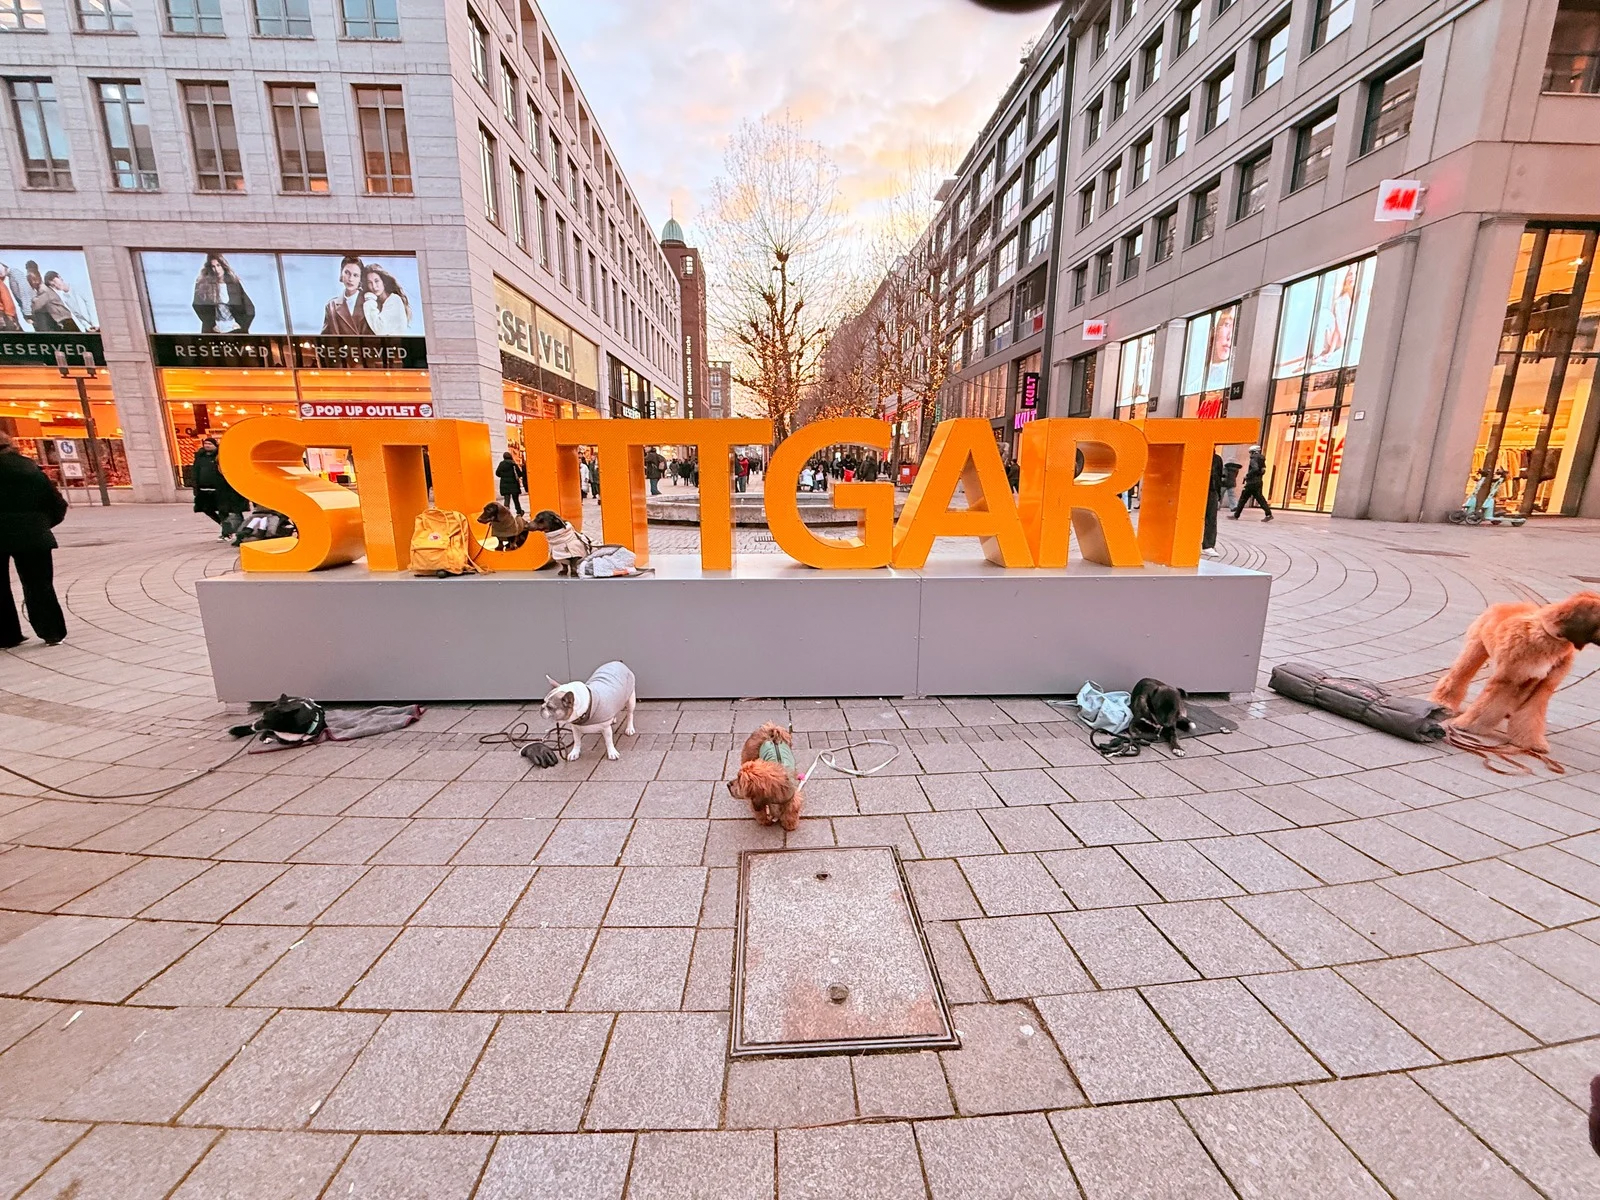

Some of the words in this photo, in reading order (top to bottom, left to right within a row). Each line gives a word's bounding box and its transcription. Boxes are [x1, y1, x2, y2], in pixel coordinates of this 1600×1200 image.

[0, 343, 87, 356] ESERVED
[174, 345, 269, 358] RESERVED
[315, 346, 408, 359] RESERVED
[1024, 375, 1036, 406] KULT
[315, 405, 343, 416] POP
[344, 405, 364, 416] UP
[365, 405, 416, 417] OUTLET
[218, 417, 1260, 573] STUTTGART
